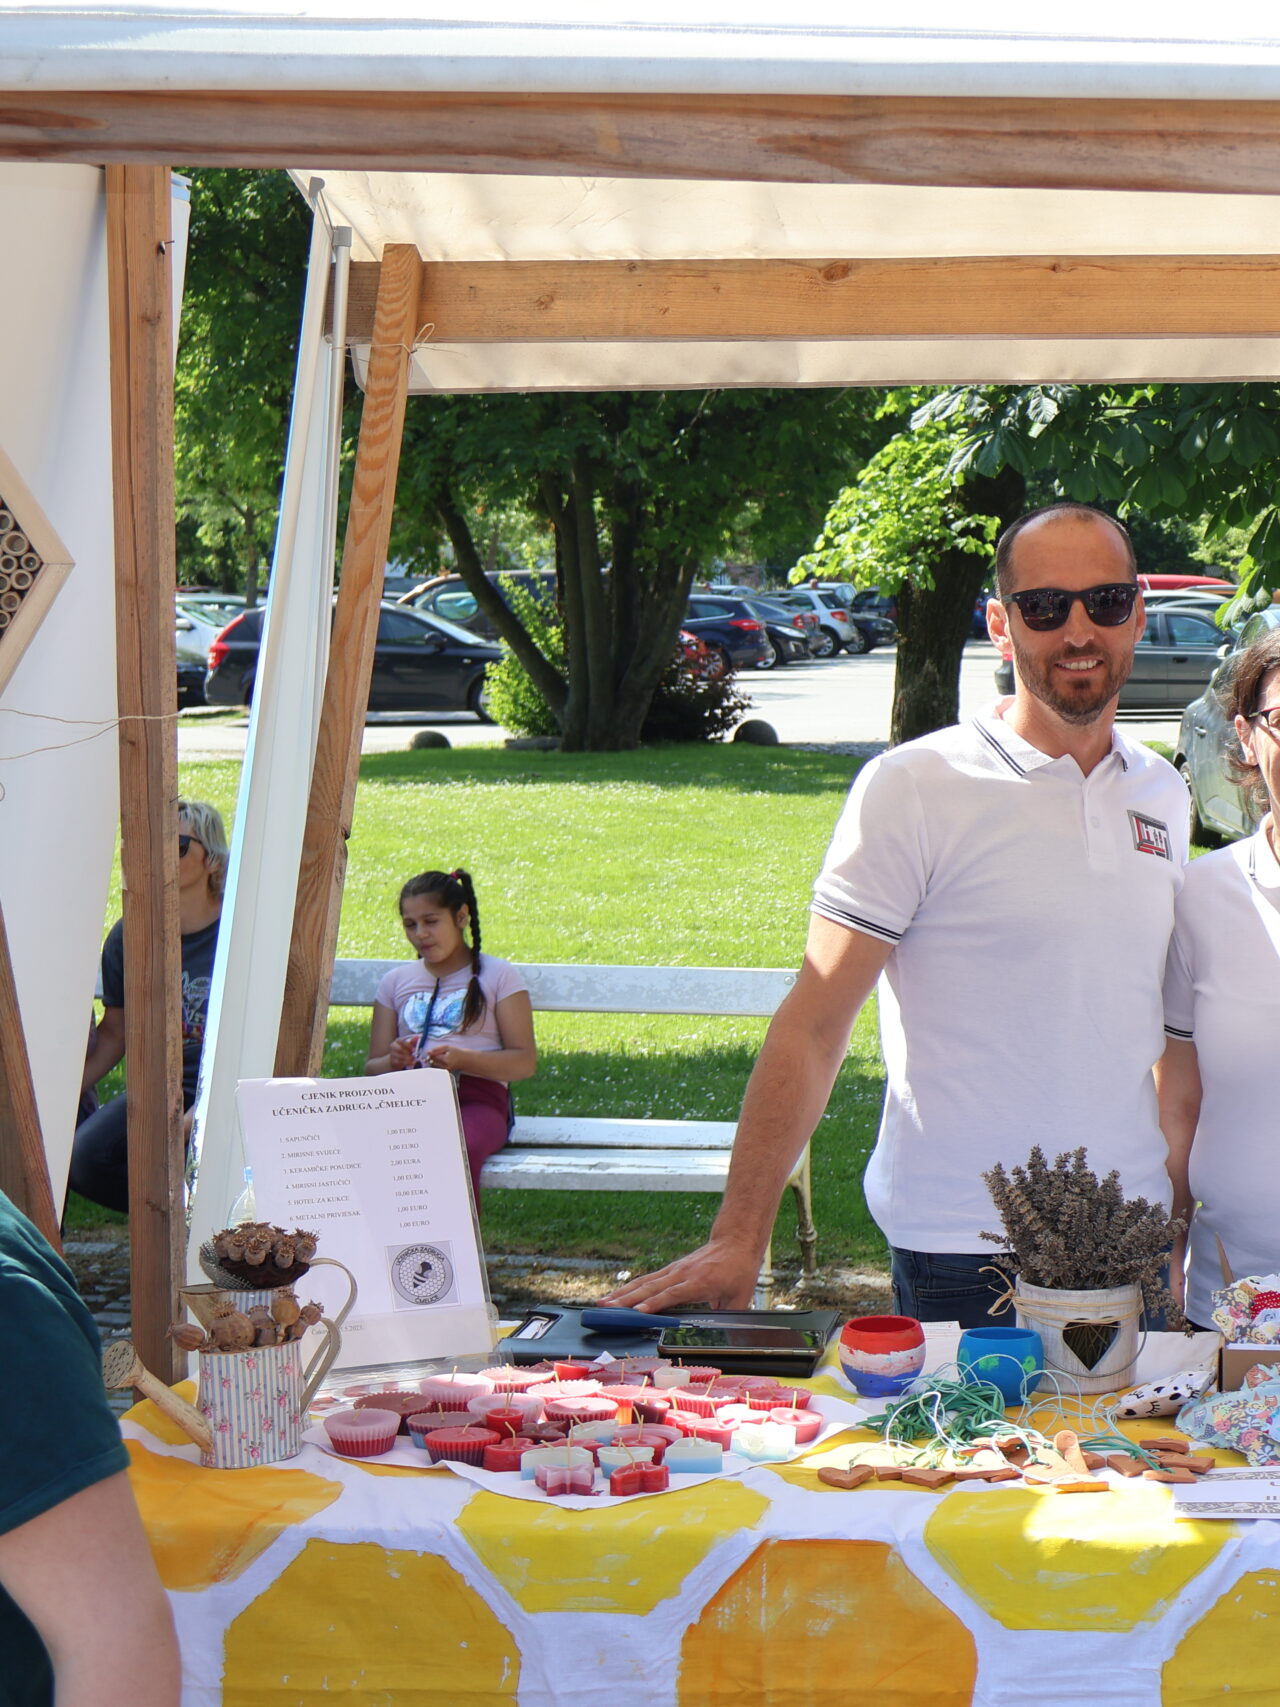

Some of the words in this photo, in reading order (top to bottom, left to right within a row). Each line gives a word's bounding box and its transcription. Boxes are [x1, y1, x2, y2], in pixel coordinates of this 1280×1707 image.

[301, 1091, 337, 1101] CJENIK
[339, 1087, 396, 1098] PROIZVODA
[272, 1105, 324, 1117] UČENIČKA
[325, 1102, 373, 1113] ZADRUGA
[399, 1127, 417, 1135] EURO
[287, 1151, 315, 1159] MIRISNE
[330, 1163, 362, 1171] POSUDICE
[291, 1182, 317, 1190] MIRISNI
[293, 1198, 315, 1206] HOTEL
[327, 1195, 350, 1203] KUKCE
[295, 1213, 326, 1221] METALNI
[326, 1210, 361, 1219] PRIVJESAK
